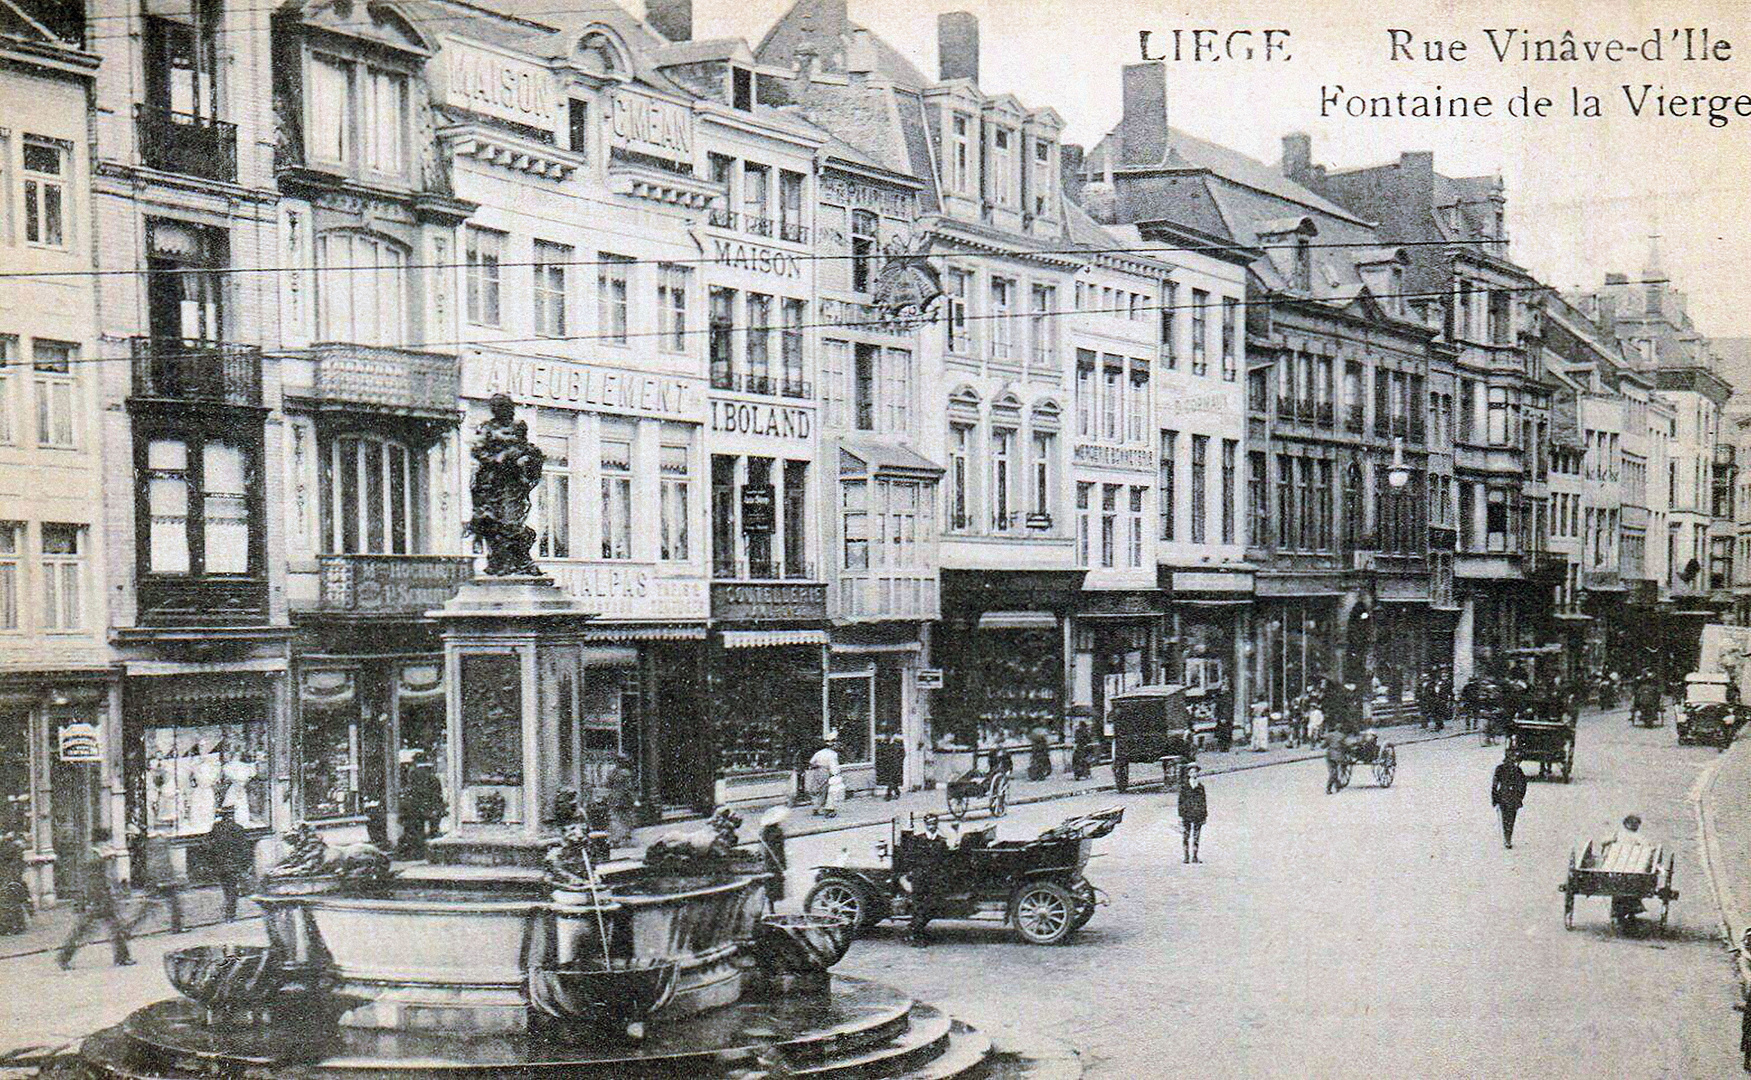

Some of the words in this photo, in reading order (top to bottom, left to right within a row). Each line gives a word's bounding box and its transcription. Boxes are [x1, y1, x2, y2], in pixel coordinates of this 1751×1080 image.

[449, 48, 553, 119] MAISON
[715, 239, 800, 278] MAISON
[485, 357, 690, 414] AMEUBLEMENT
